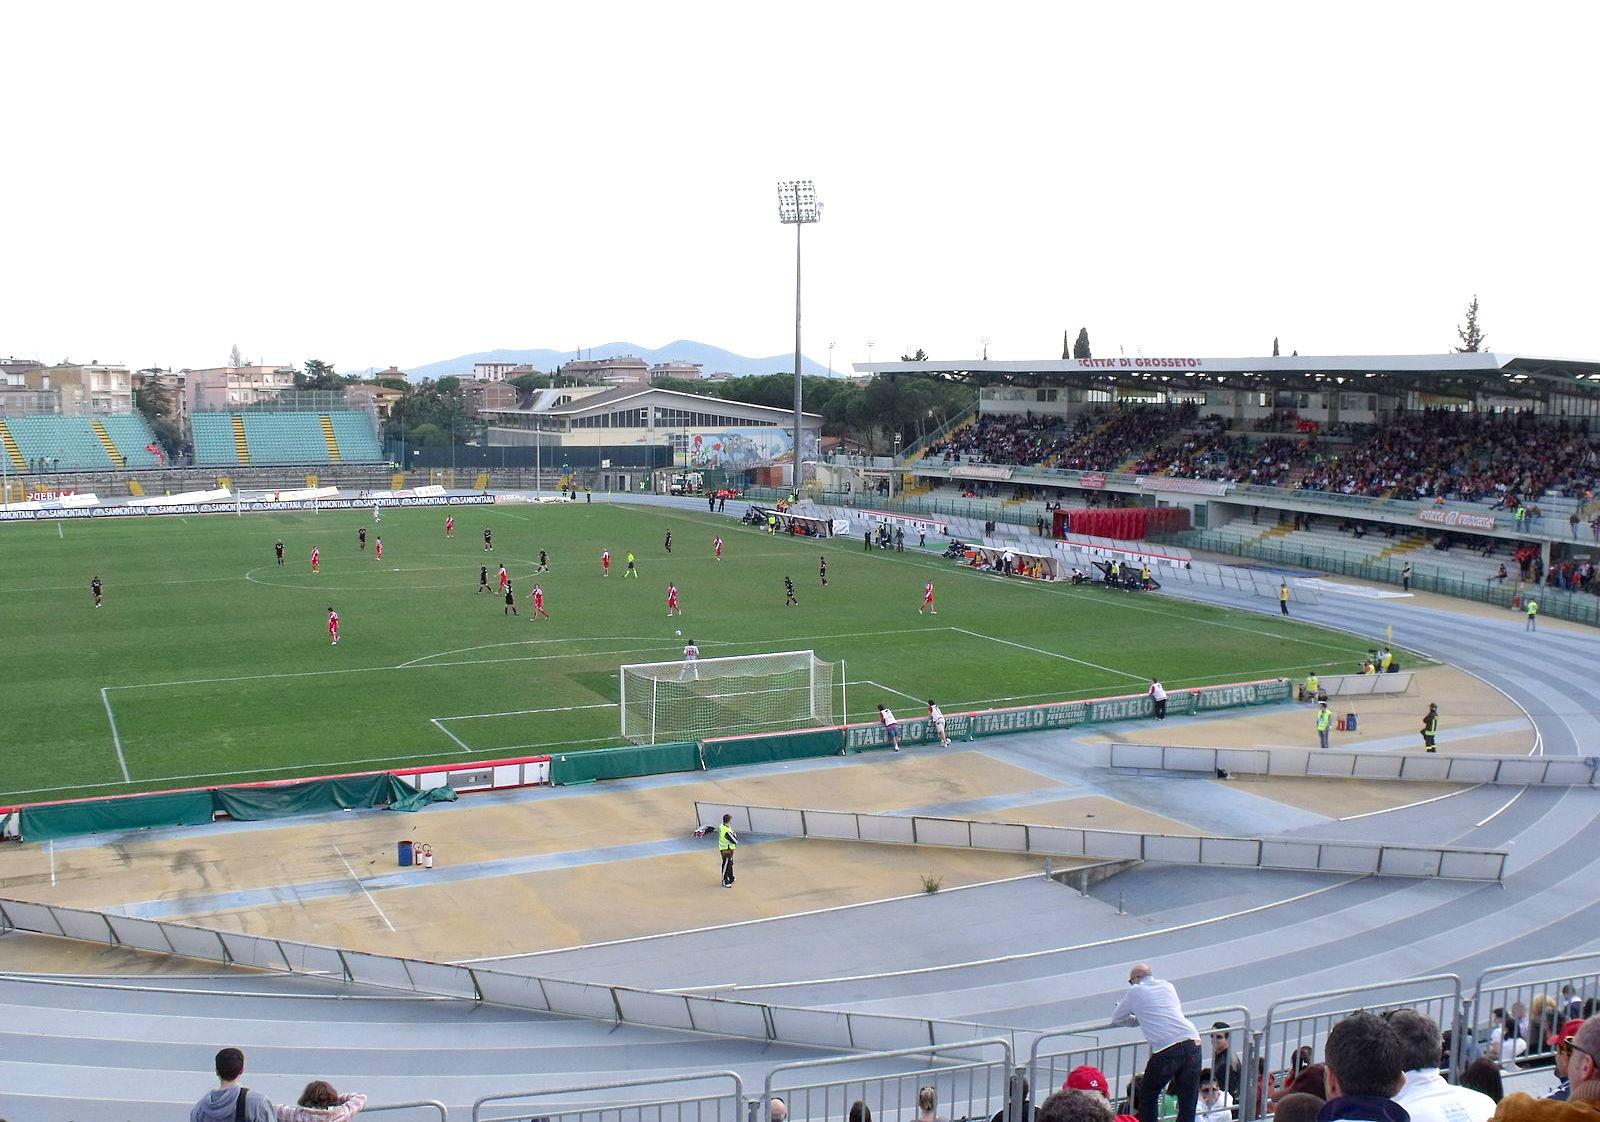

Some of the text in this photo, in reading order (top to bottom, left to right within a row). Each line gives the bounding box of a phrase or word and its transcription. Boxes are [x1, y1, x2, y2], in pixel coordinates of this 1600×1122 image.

[1120, 358, 1131, 367] DI
[1136, 358, 1197, 367] GROSSETO
[364, 498, 400, 508] SAMMONTANA
[412, 497, 448, 505] SAMMONTANA
[460, 495, 494, 504] SAMMONTANA
[105, 506, 145, 516] SAMMONTANA
[160, 504, 199, 514] SAMMONTANA
[263, 501, 302, 511] SAMMONTANA
[49, 508, 91, 518] SAMMONTANA
[1200, 686, 1256, 707] ITALTELO
[1092, 699, 1153, 721] ITALTELO
[976, 710, 1044, 732] ITALTELO
